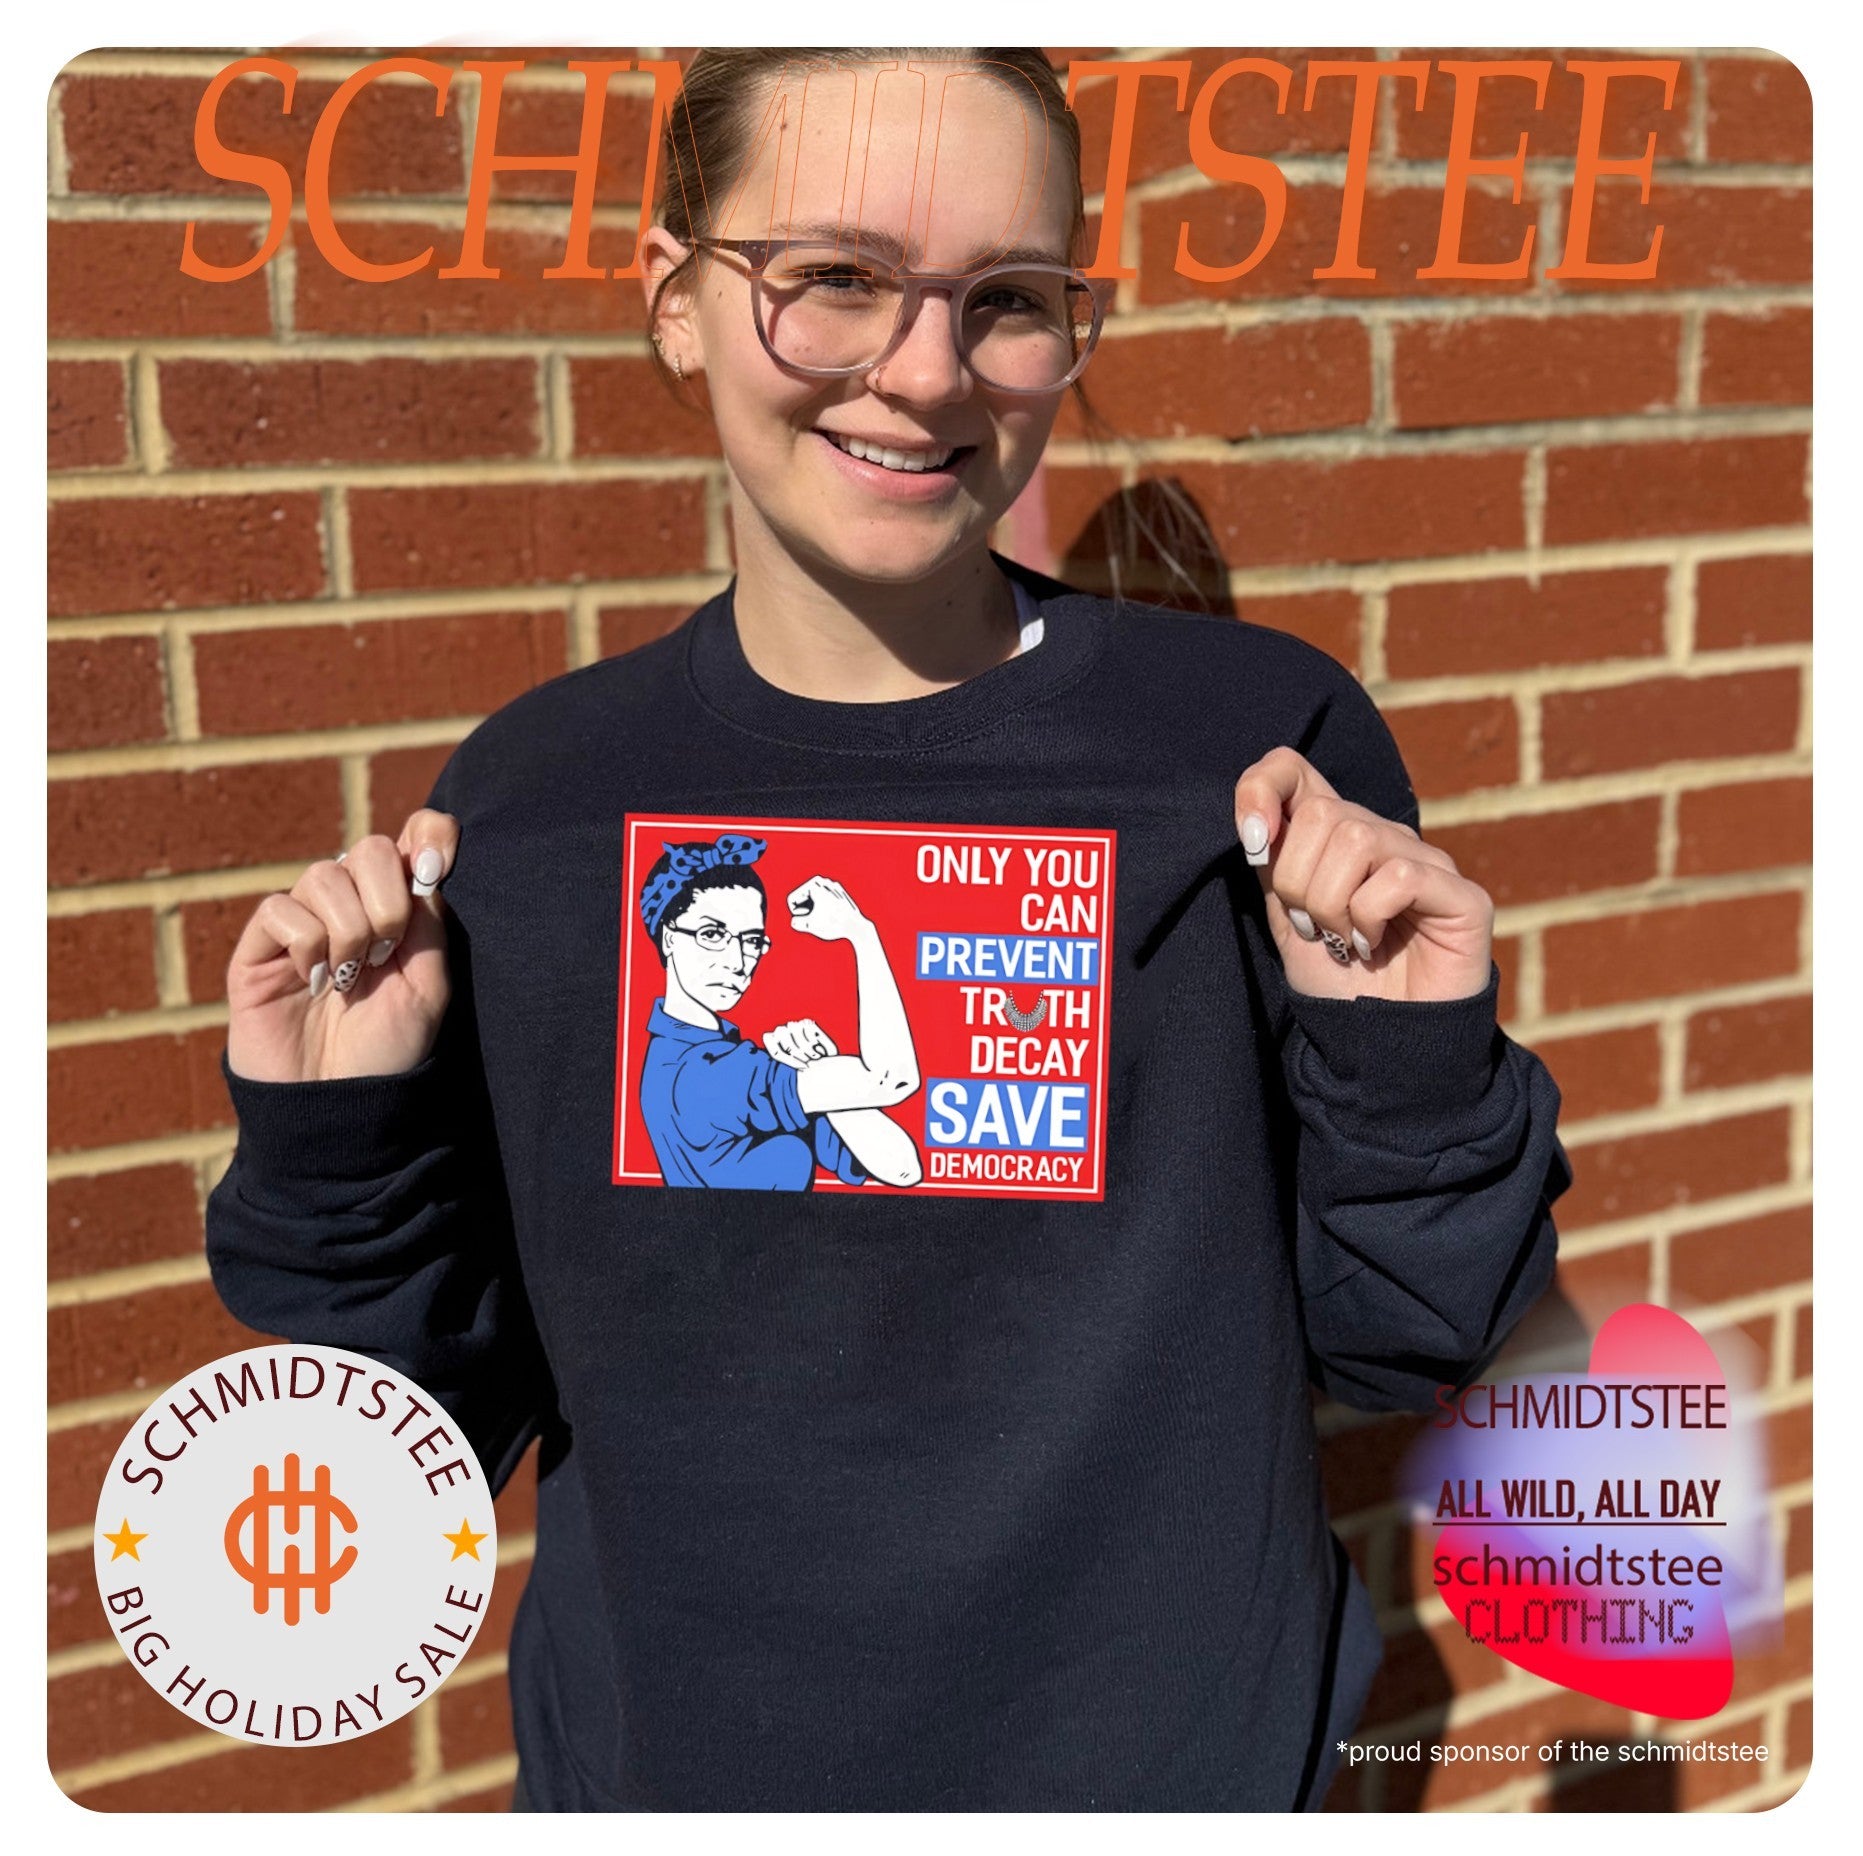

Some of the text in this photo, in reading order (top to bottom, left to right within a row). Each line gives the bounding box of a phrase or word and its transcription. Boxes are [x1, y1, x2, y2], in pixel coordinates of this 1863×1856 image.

[916, 844, 1099, 888] ONLY YOU
[1020, 893, 1097, 933] CAN
[921, 937, 1098, 981] PREVENT
[970, 1035, 1090, 1077] DECAY
[929, 1081, 1086, 1148] SAVE
[930, 1152, 1084, 1183] DEMOCRACY
